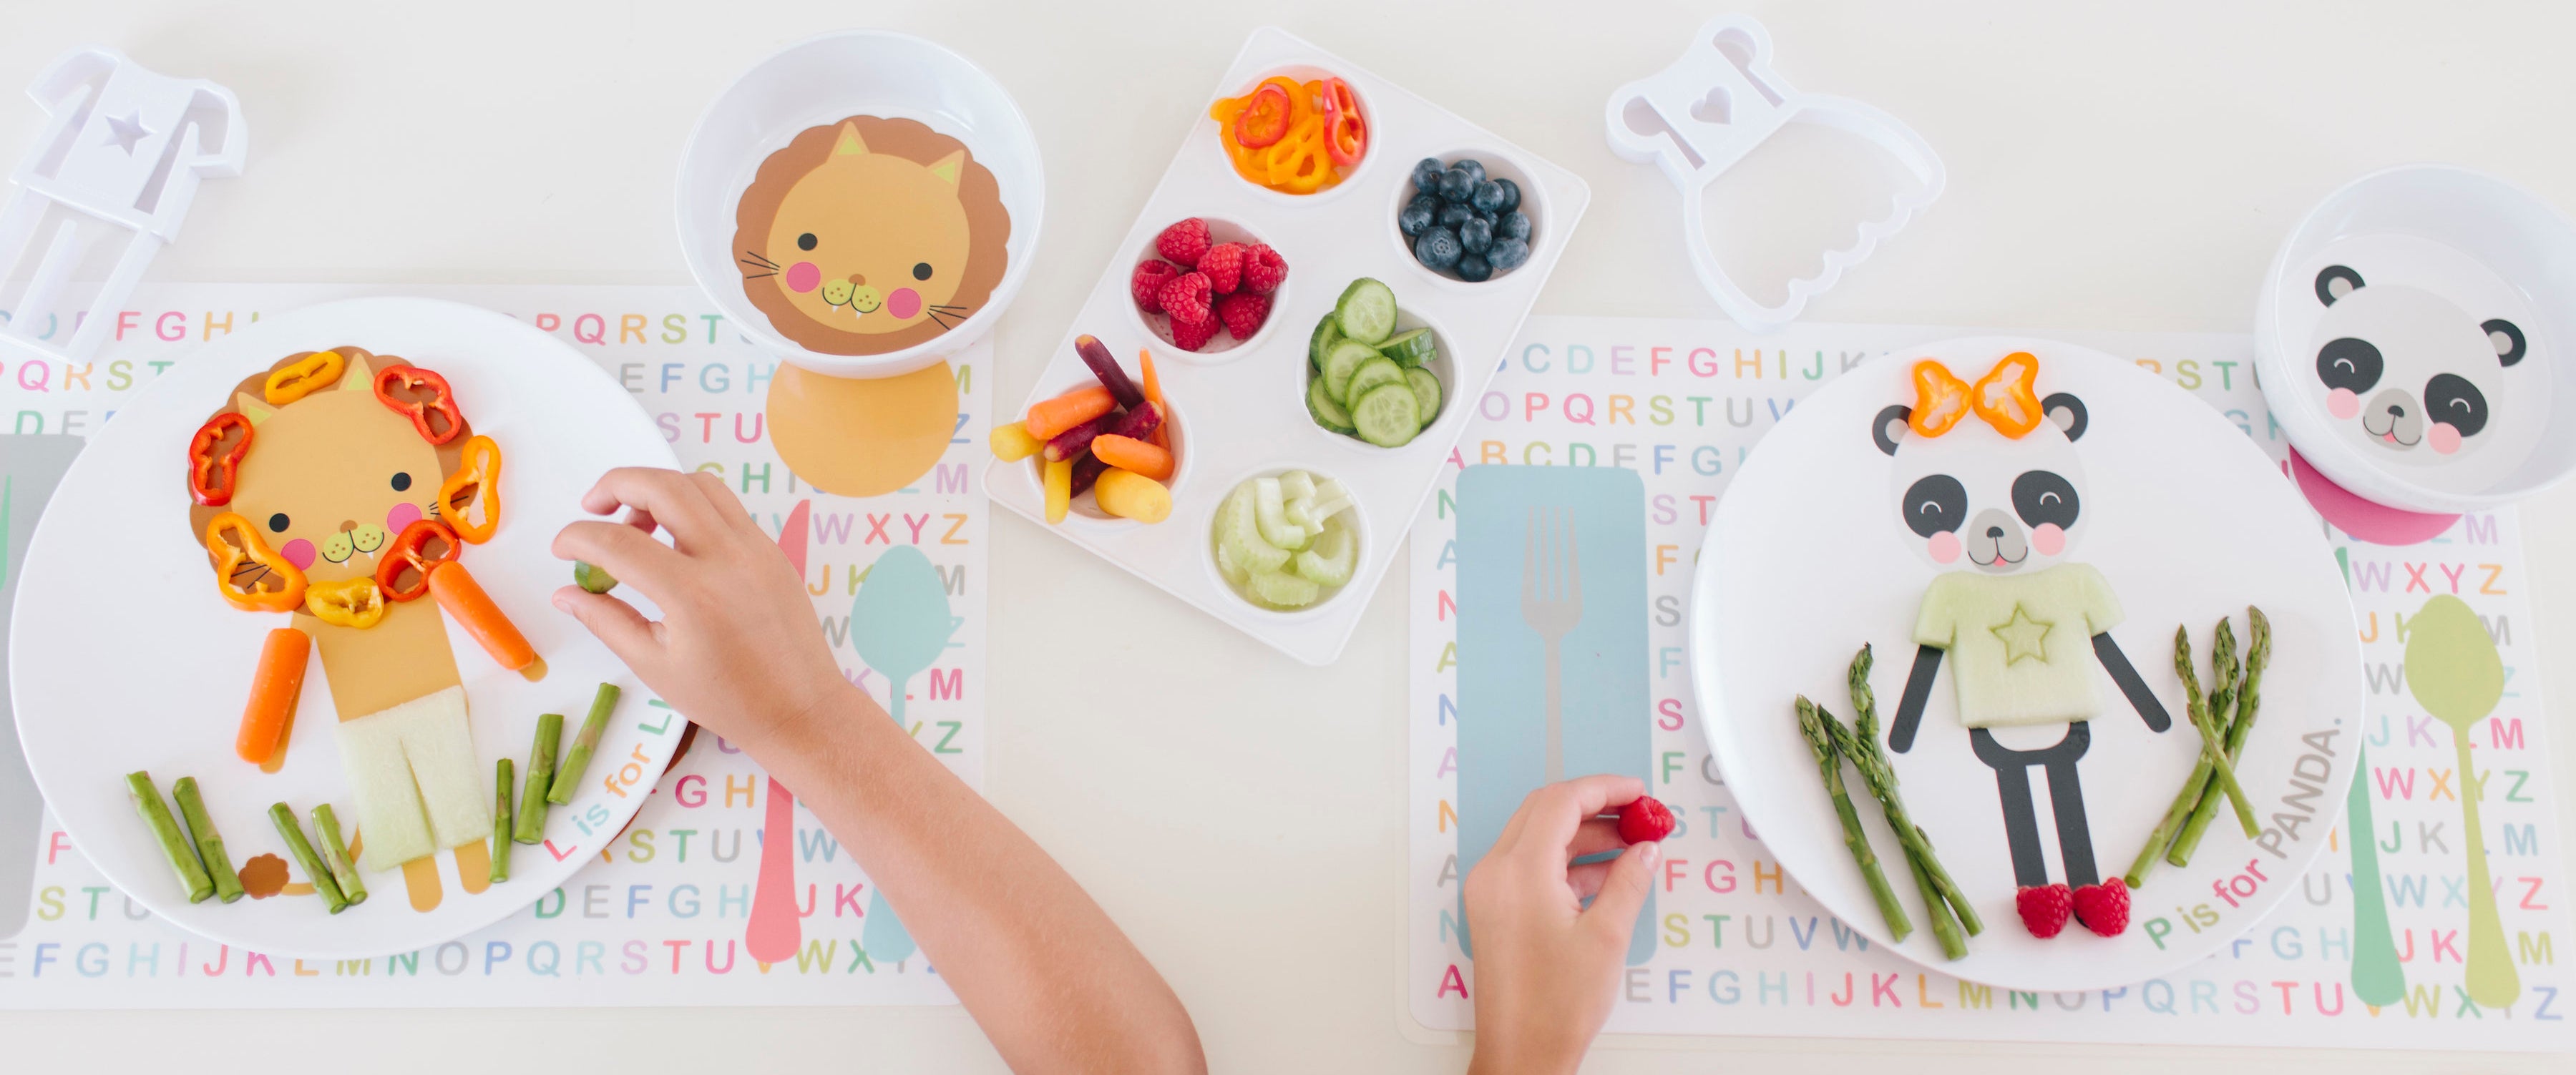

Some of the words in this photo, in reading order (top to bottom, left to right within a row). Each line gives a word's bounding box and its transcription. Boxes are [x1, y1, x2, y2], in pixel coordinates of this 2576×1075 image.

[544, 839, 577, 862] L
[572, 803, 610, 836] is
[604, 742, 650, 798] for
[2144, 918, 2172, 950] P
[2176, 904, 2219, 933] is
[2212, 859, 2268, 908] for
[2255, 718, 2342, 860] PANDA.
